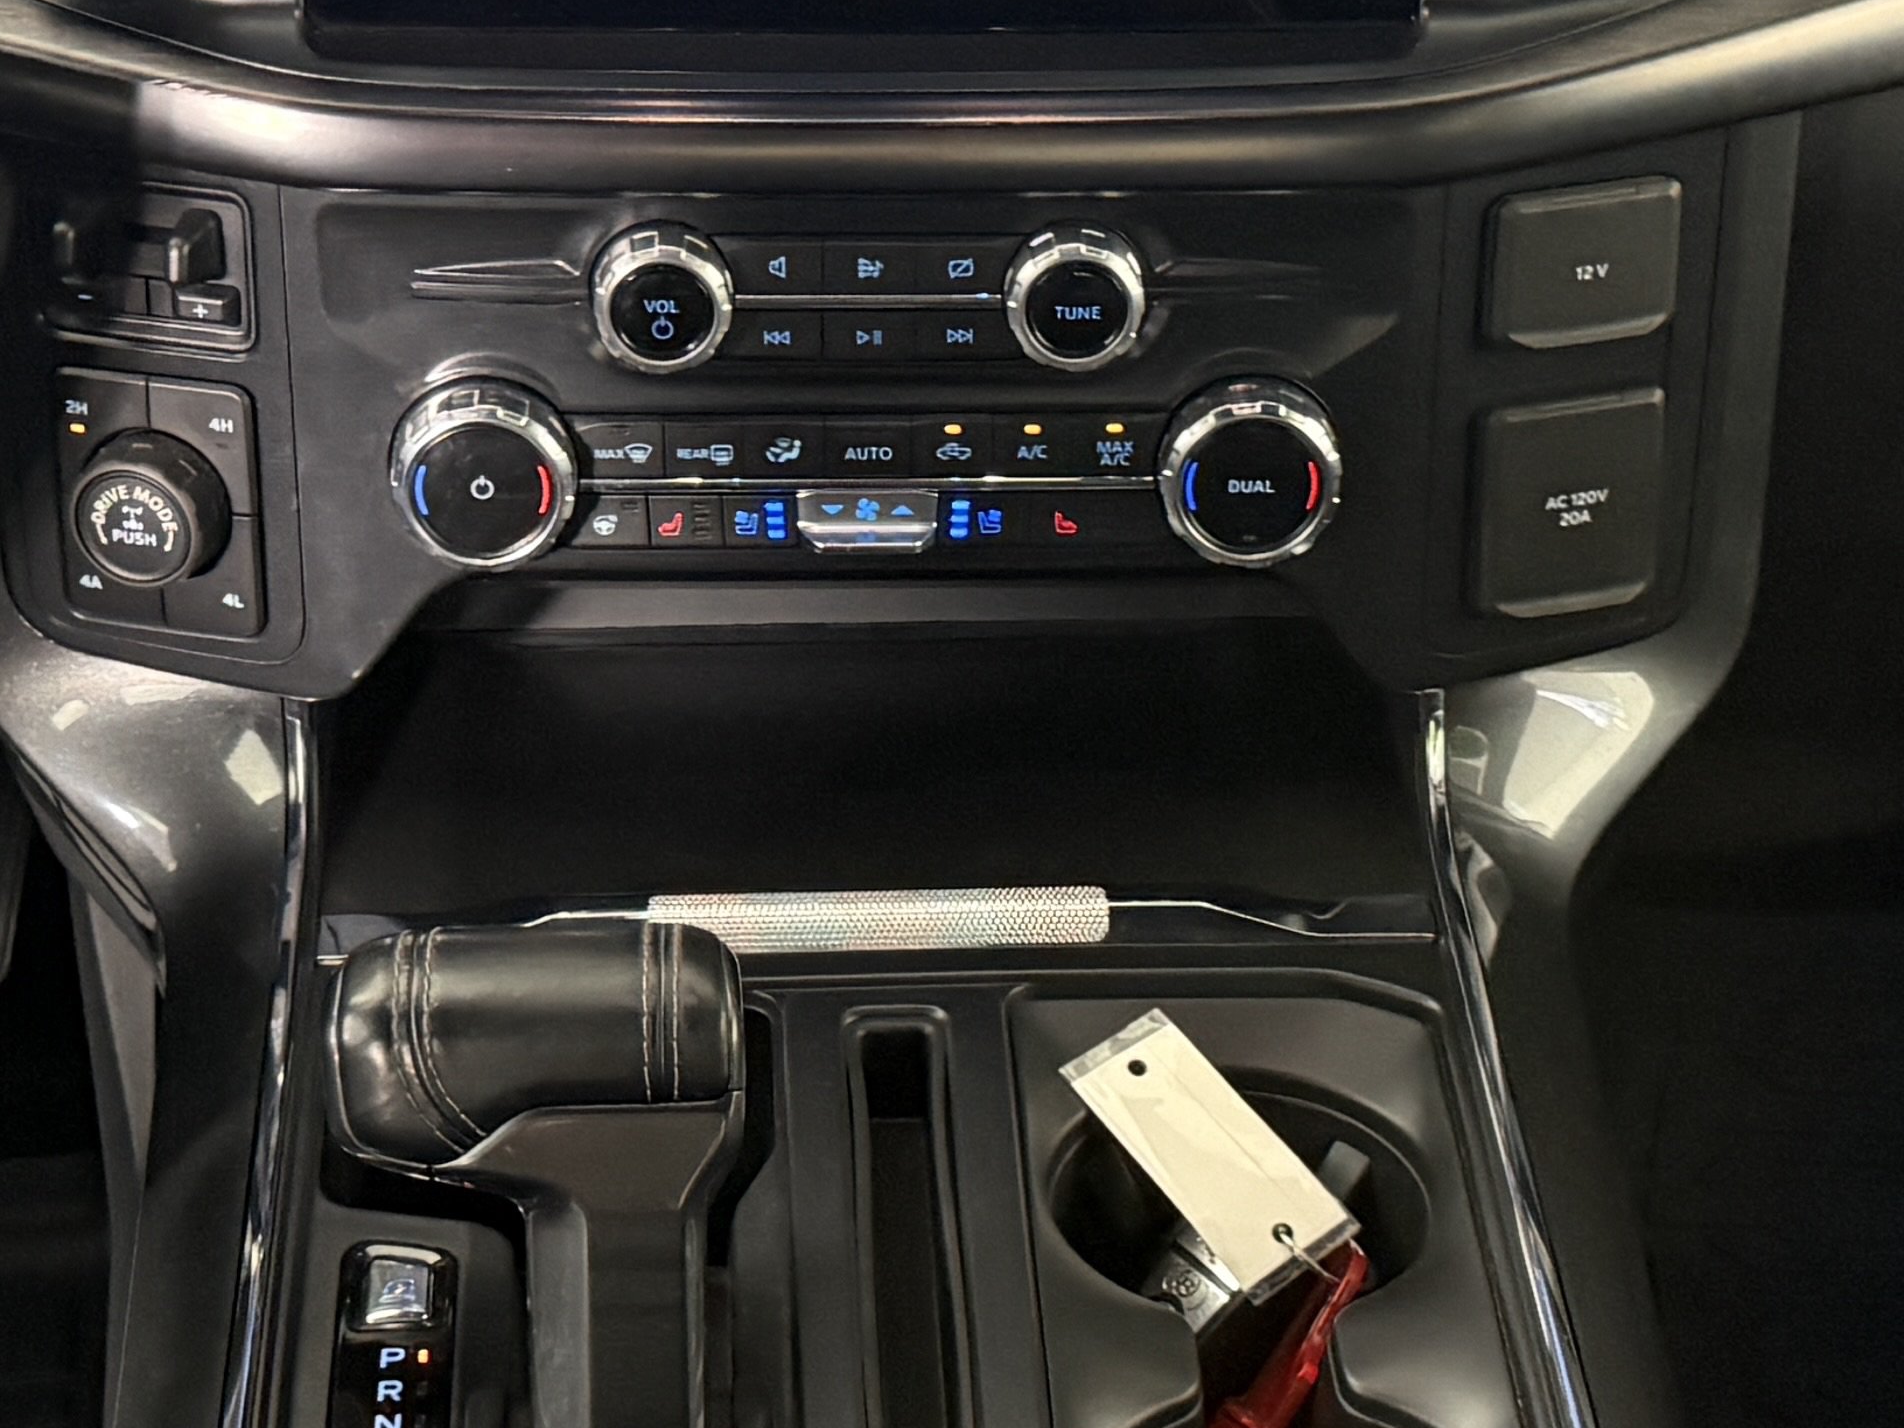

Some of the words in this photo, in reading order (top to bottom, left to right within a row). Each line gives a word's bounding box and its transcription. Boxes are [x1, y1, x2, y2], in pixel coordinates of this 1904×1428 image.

[1575, 264, 1595, 281] 12
[643, 299, 680, 315] VOL
[1054, 305, 1102, 321] TUNE
[65, 399, 88, 416] 2H
[208, 418, 234, 433] 4H
[594, 446, 624, 461] MAX
[677, 446, 710, 461] REAR
[844, 446, 893, 462] AUTO
[1016, 445, 1048, 461] A/C
[1096, 441, 1134, 455] MAX
[1099, 451, 1131, 466] A/C
[1227, 479, 1276, 494] DUAL
[1545, 494, 1570, 511] AC
[1571, 488, 1609, 507] 120V
[91, 484, 130, 526] DRIVE
[133, 485, 179, 532] MODE
[1559, 509, 1592, 527] 20A
[112, 530, 157, 548] PUSH
[79, 574, 103, 590] 4A
[222, 592, 245, 609] 4L
[379, 1347, 406, 1369] P
[376, 1379, 404, 1403] R
